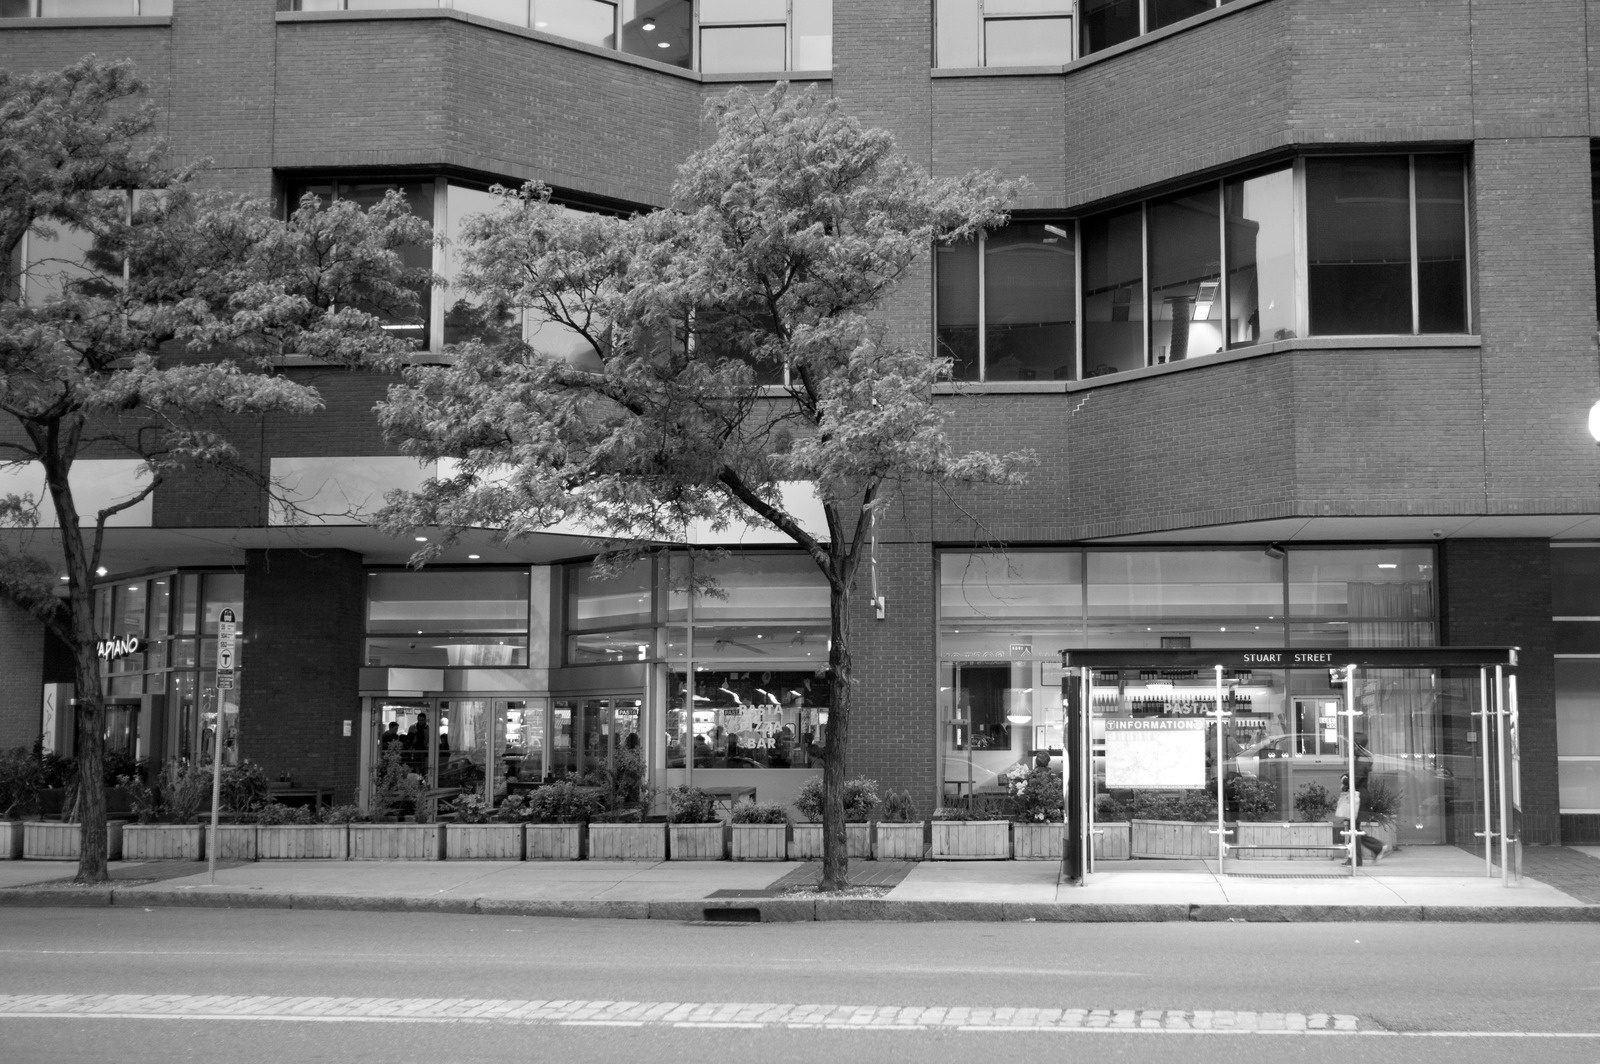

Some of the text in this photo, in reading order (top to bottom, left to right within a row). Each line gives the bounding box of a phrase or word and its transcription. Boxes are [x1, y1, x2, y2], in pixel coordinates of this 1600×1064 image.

[1243, 653, 1333, 662] STUART STREET
[739, 704, 784, 715] PASTA
[1163, 703, 1209, 714] PASTA
[1115, 720, 1194, 729] INFORMATION
[747, 737, 776, 749] BAR
